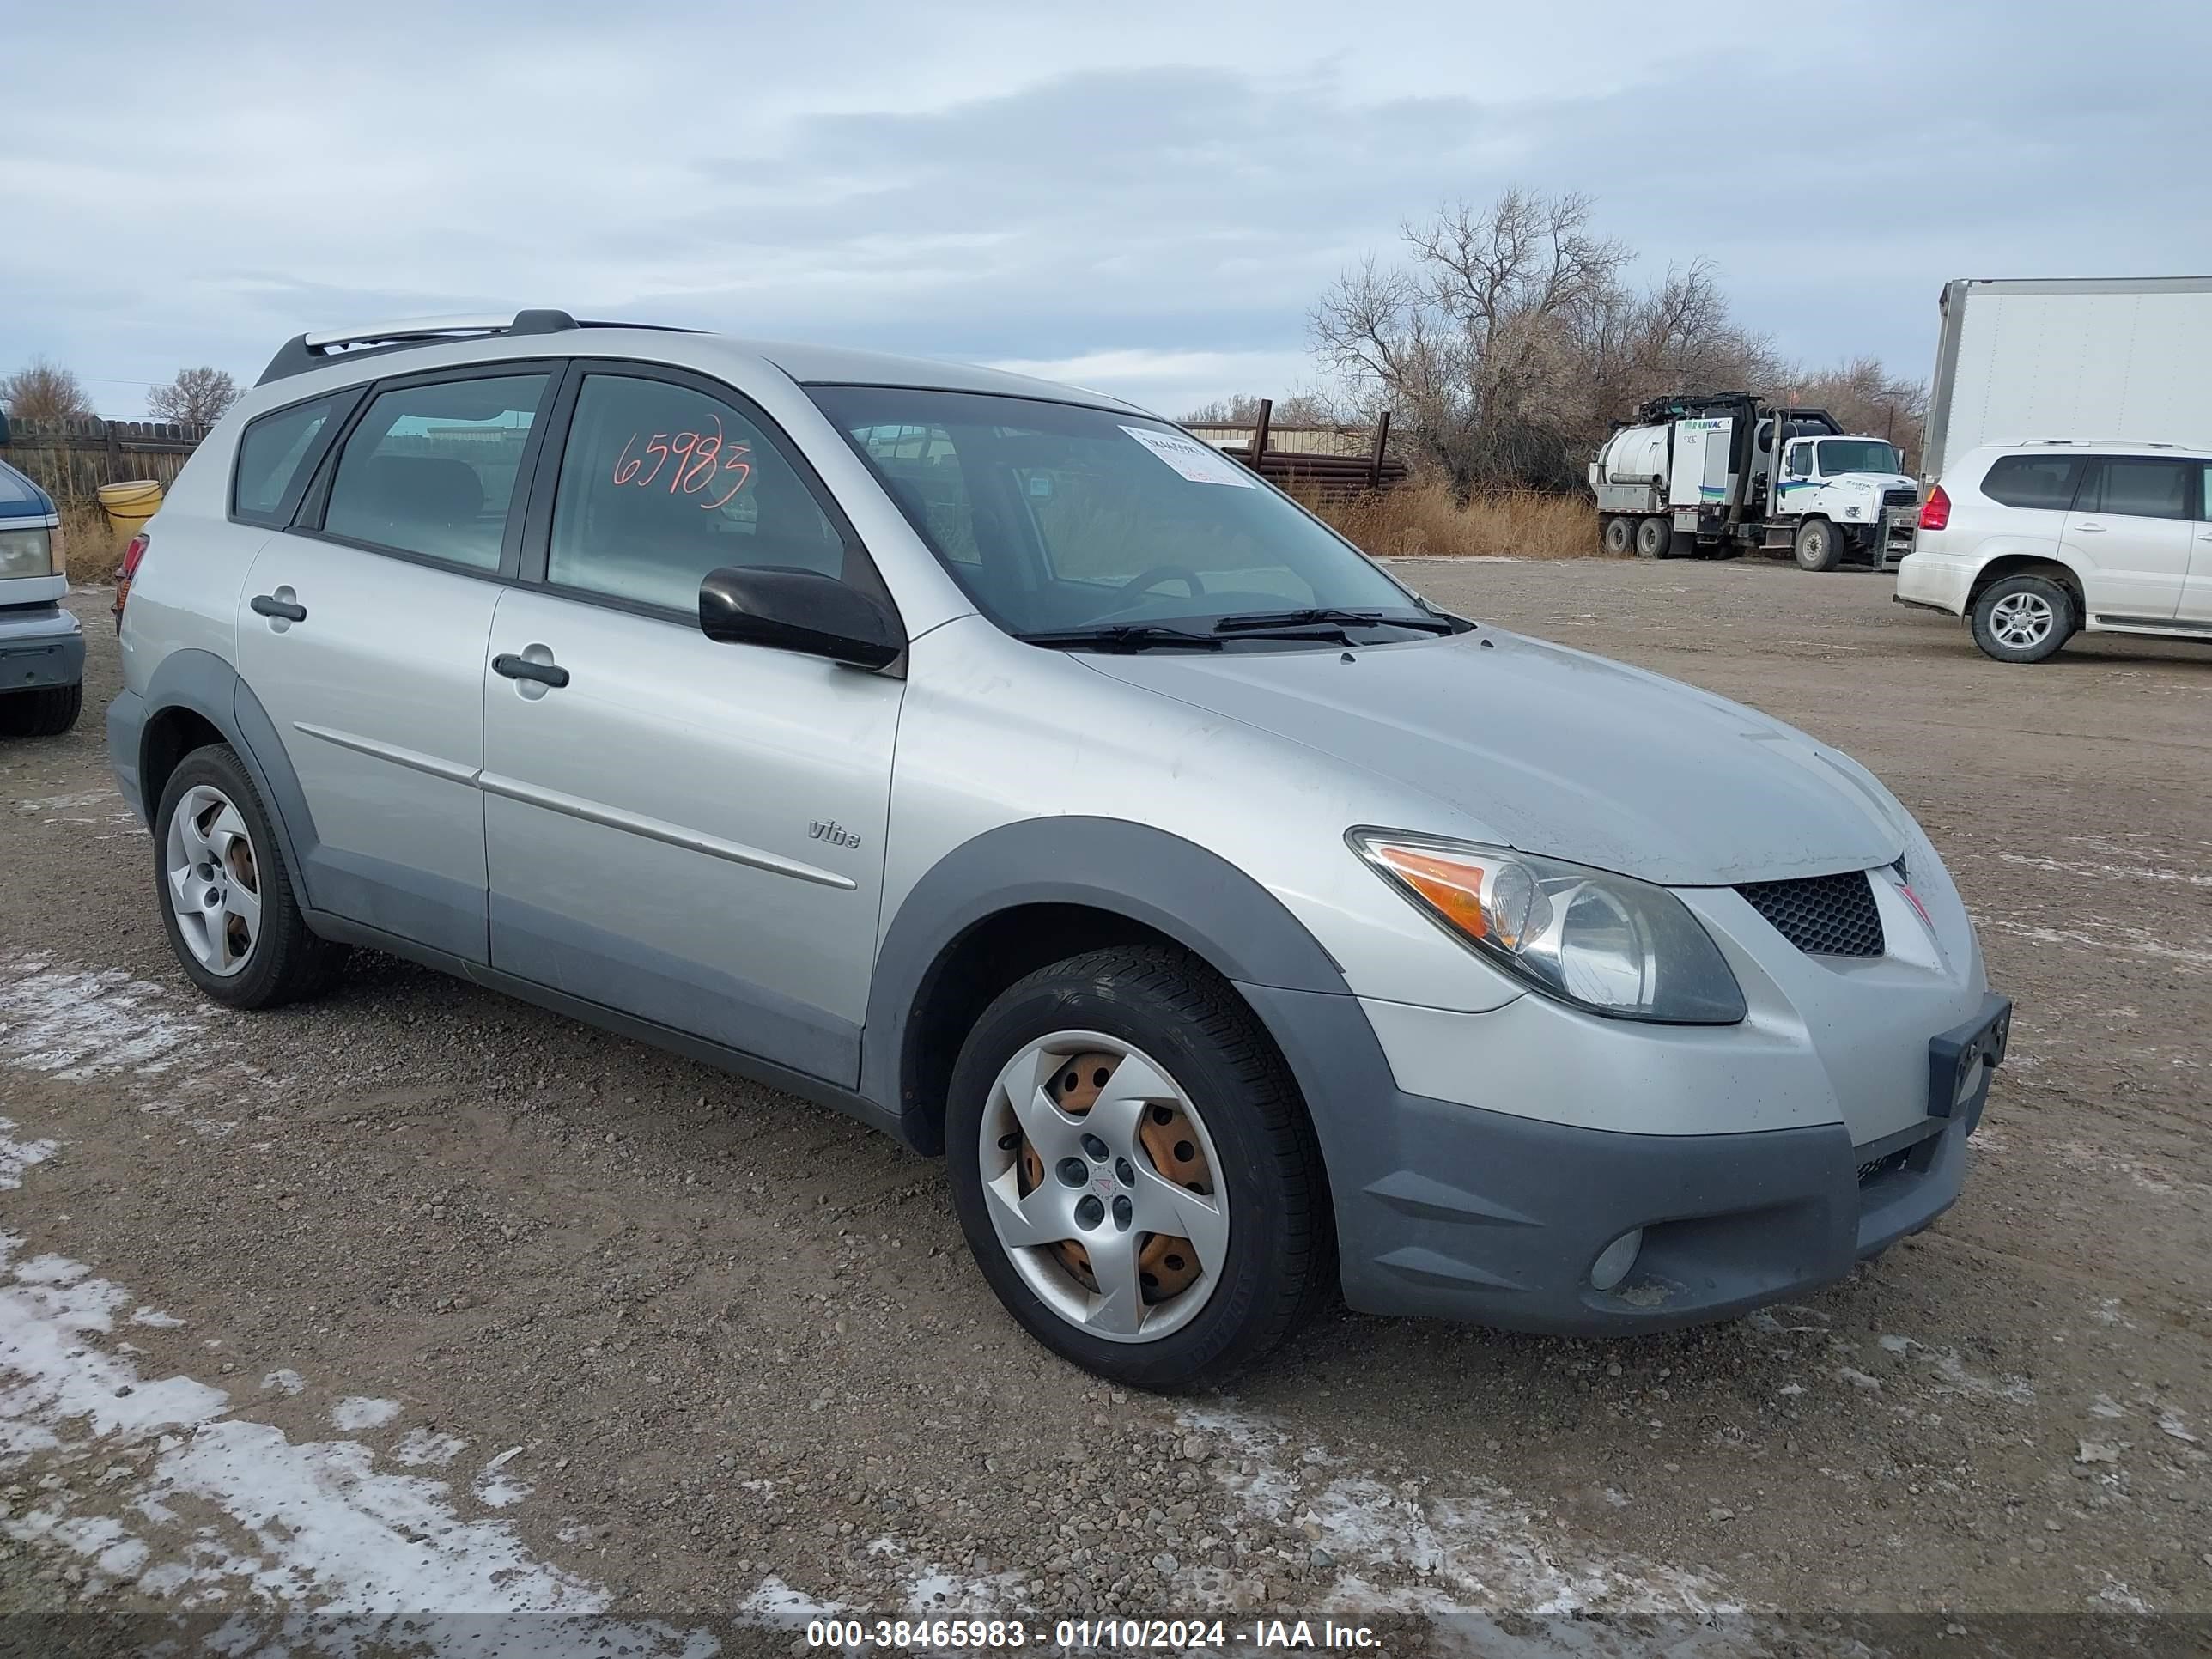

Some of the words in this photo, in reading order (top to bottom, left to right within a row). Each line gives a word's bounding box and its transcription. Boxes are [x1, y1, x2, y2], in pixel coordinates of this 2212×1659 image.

[1692, 420, 1723, 430] RAMVAC
[613, 414, 750, 509] 65983
[808, 818, 861, 849] vibe
